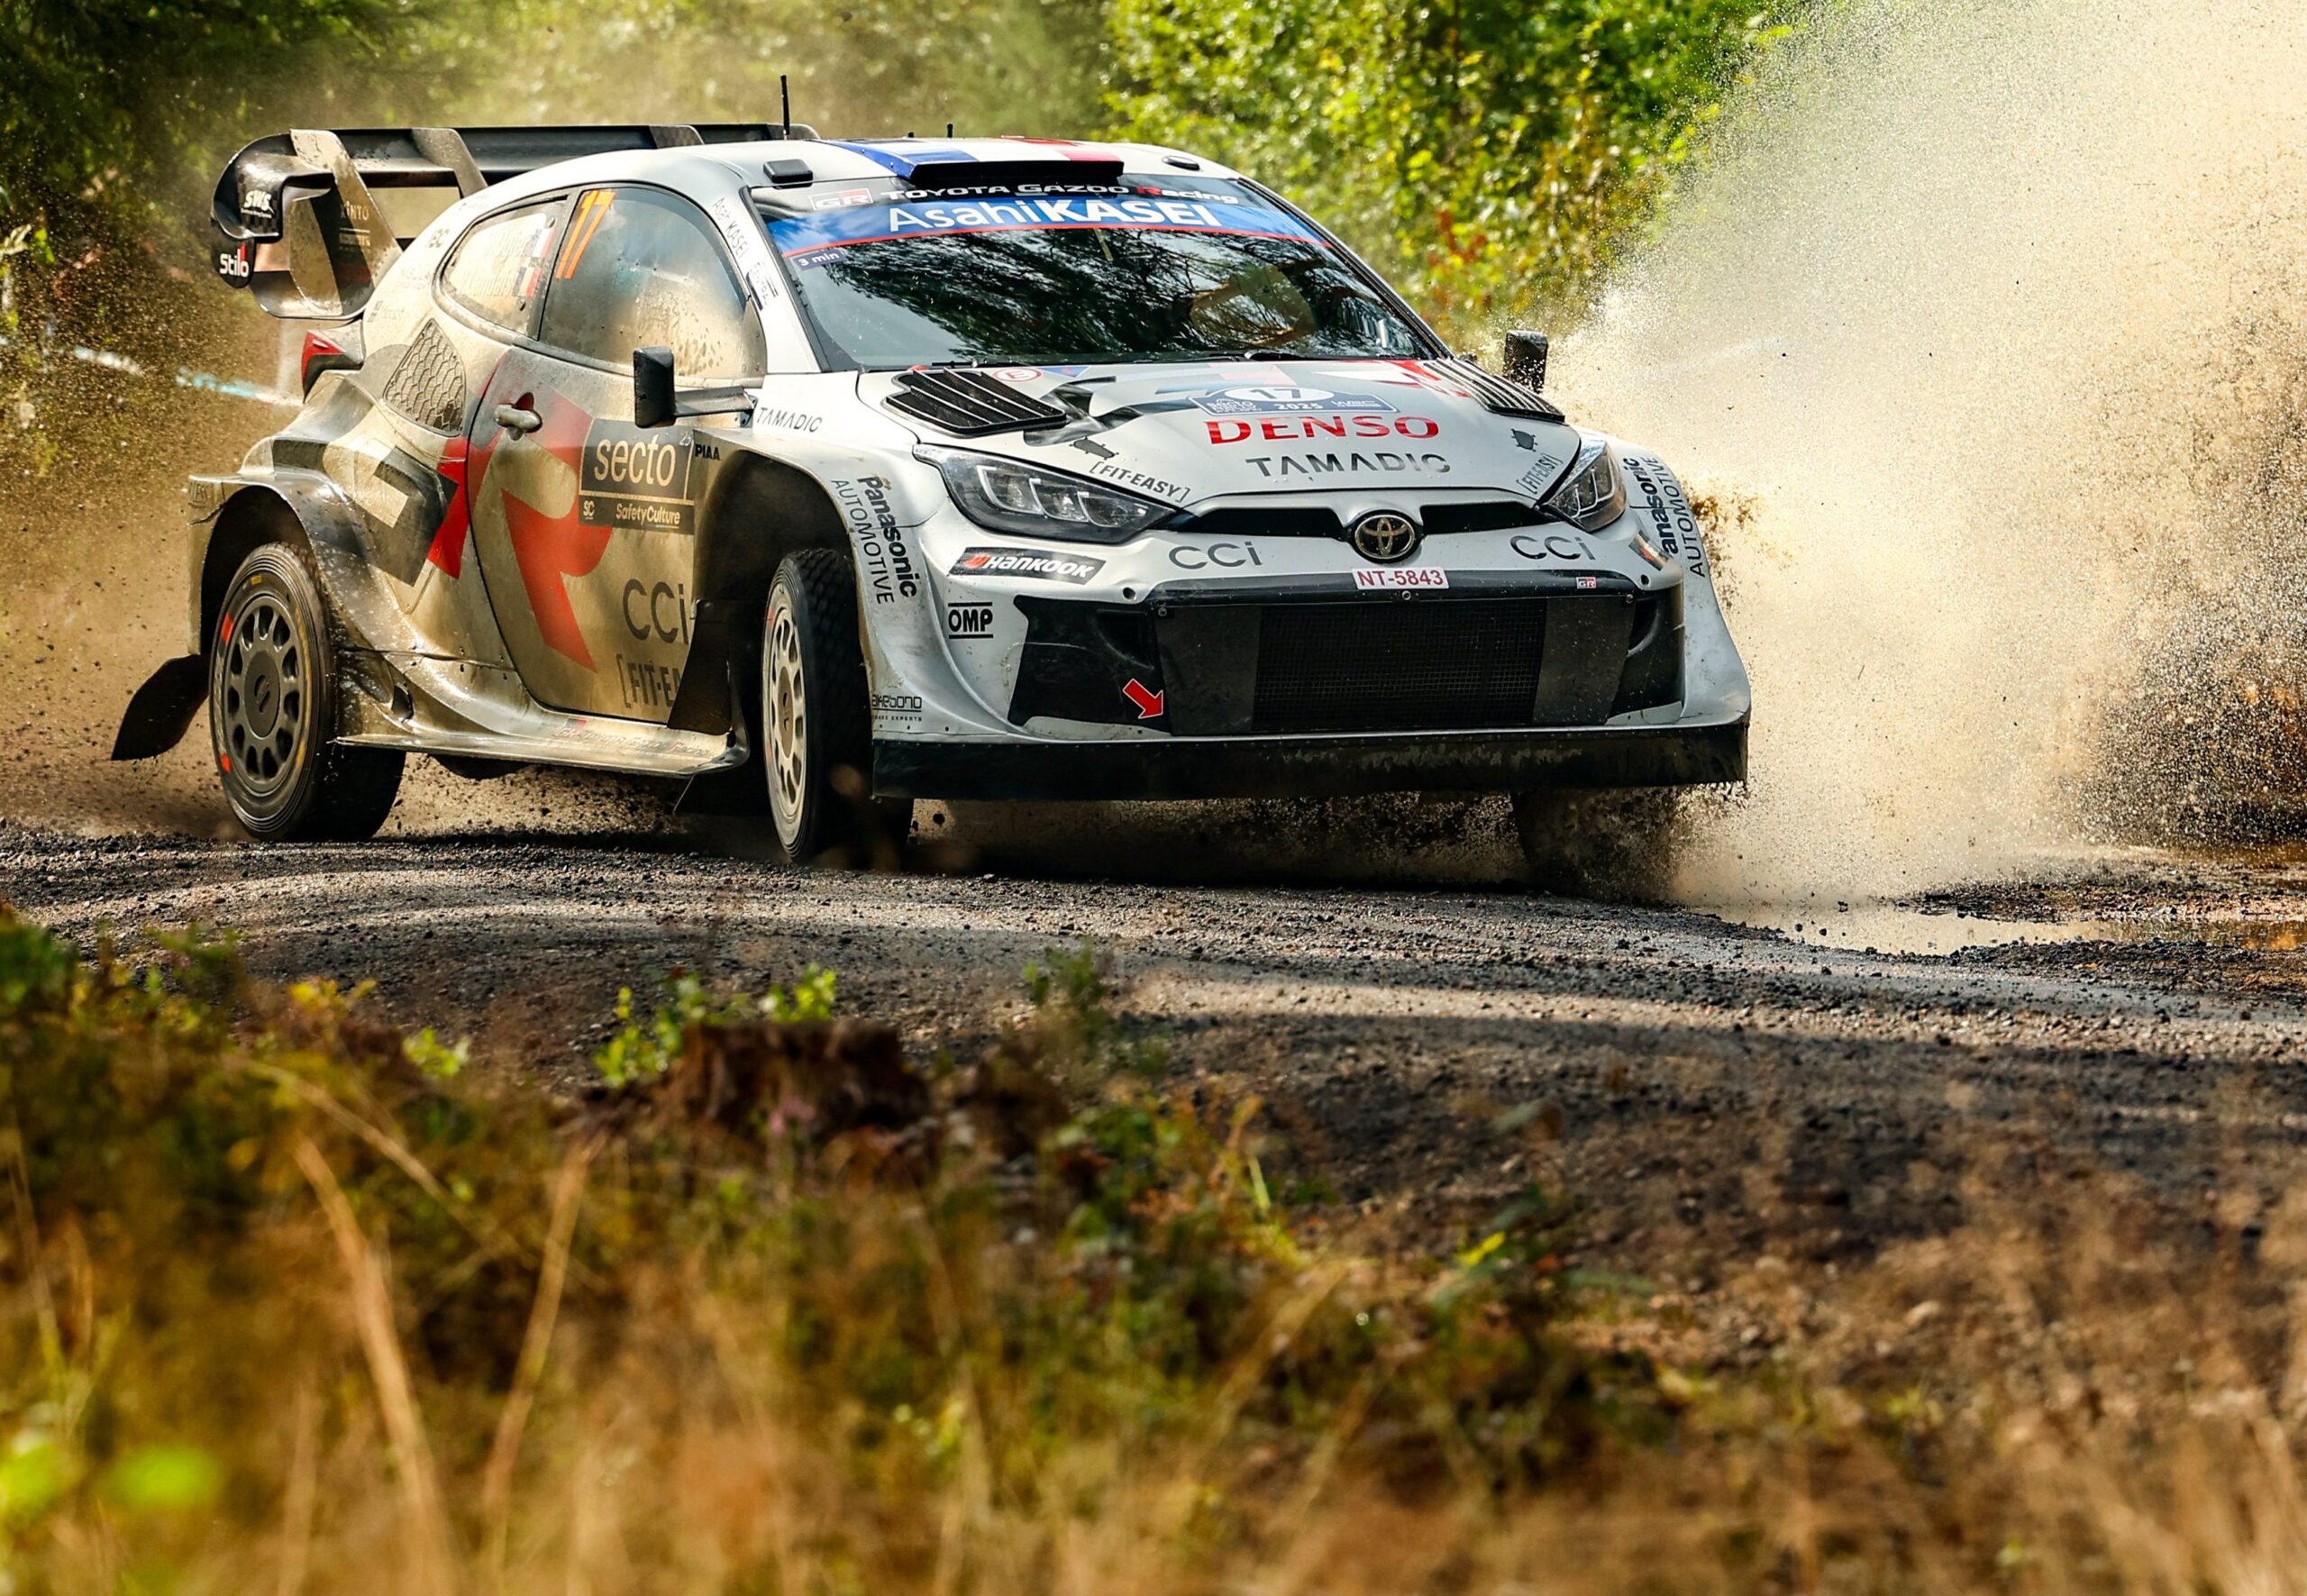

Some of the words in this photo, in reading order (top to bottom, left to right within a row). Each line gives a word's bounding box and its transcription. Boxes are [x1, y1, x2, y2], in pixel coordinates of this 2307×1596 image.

[880, 185, 1010, 200] TOYOTA
[1017, 183, 1129, 195] GAZOO
[1135, 187, 1239, 205] Racing
[554, 188, 616, 280] 17
[219, 248, 250, 278] Stilo
[798, 258, 809, 267] 3
[811, 252, 840, 263] min
[1249, 388, 1301, 400] 17
[1273, 402, 1324, 410] 2025
[757, 407, 823, 433] TAMADIC
[1204, 415, 1440, 445] DENSO
[594, 434, 676, 487] secto
[695, 443, 721, 461] PIAA
[1245, 452, 1452, 478] TAMADIC
[616, 502, 681, 525] SafetyCulture
[1623, 458, 1679, 555] anasonic
[1640, 457, 1706, 578] AUTOMOTIVE
[831, 479, 895, 605] AUTOMOTIVE
[856, 475, 917, 598] Panasonic
[1357, 570, 1444, 586] NT-5843
[948, 609, 993, 633] OMP
